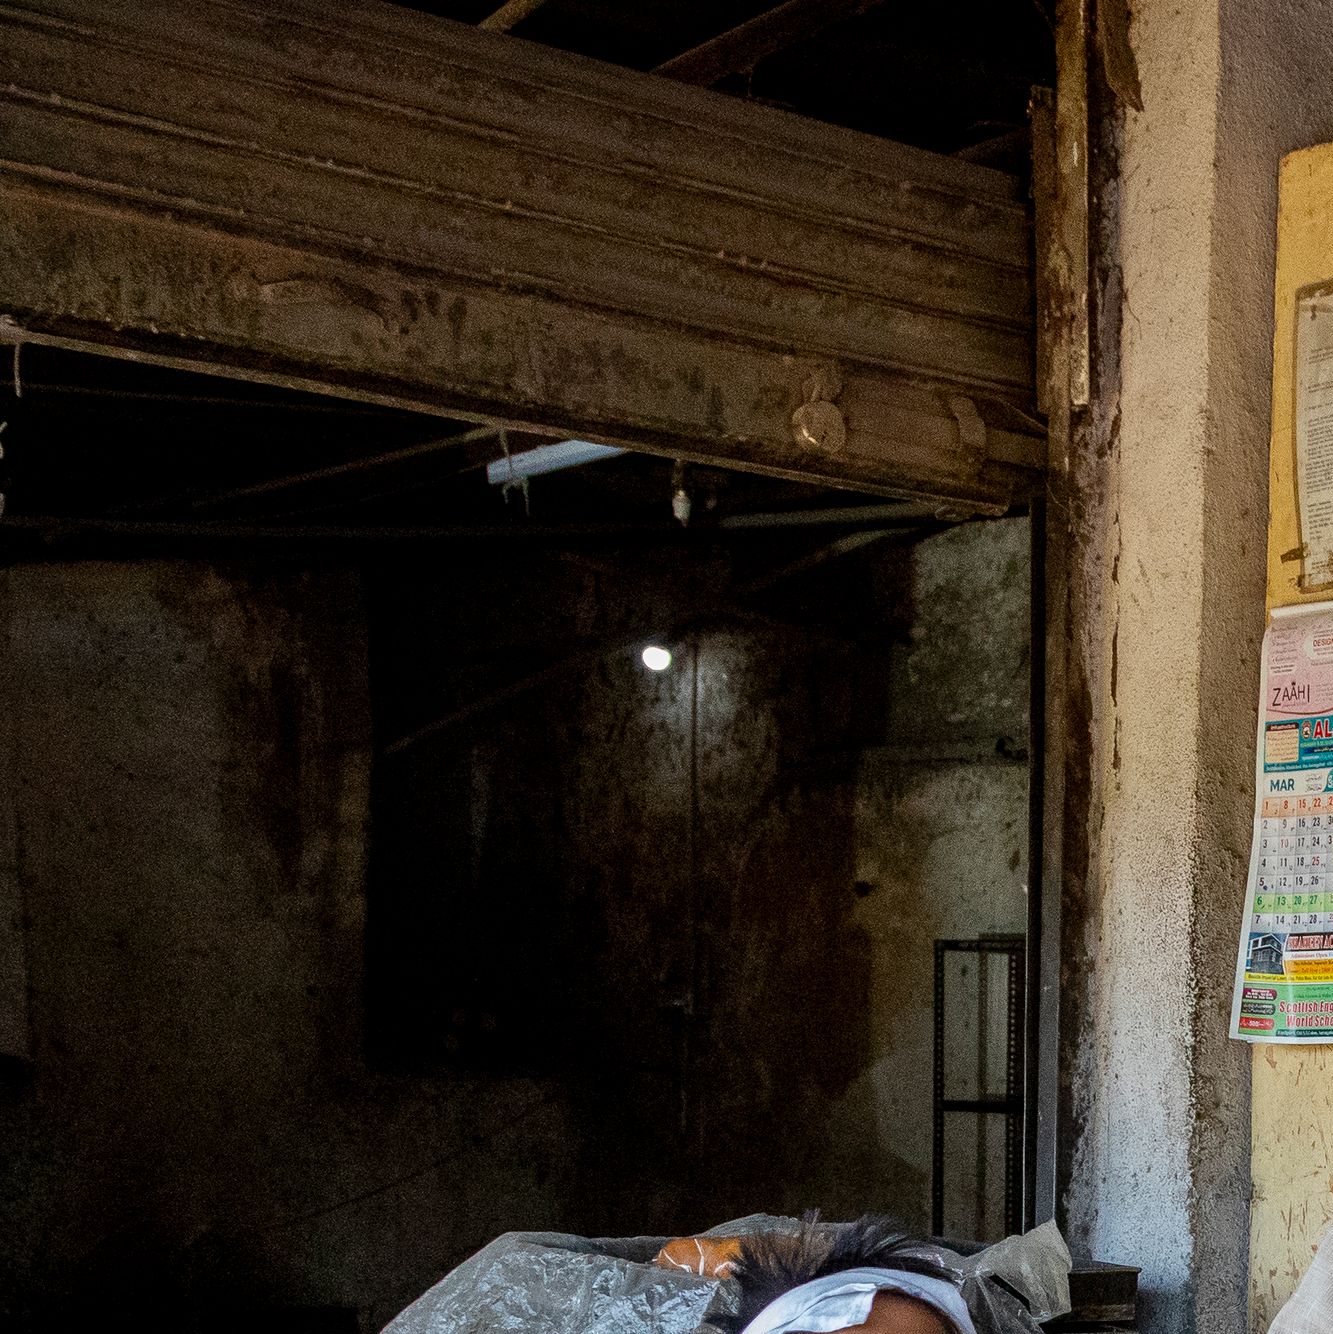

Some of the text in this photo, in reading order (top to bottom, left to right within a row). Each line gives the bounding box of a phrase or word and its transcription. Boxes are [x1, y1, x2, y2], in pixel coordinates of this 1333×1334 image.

[1270, 779, 1295, 792] MAR
[1265, 802, 1268, 810] 1
[1284, 800, 1288, 809] 8
[1300, 799, 1306, 808] 15
[1314, 798, 1320, 806] 22
[1263, 820, 1267, 829] 2
[1283, 819, 1287, 828] 9
[1313, 817, 1320, 826] 23
[1263, 840, 1267, 848] 3
[1298, 838, 1305, 846] 17
[1312, 837, 1320, 846] 24
[1262, 859, 1266, 867] 4
[1281, 858, 1288, 866] 11
[1297, 857, 1304, 866] 18
[1312, 857, 1320, 865] 25
[1260, 877, 1264, 886] 5
[1280, 877, 1287, 886] 12
[1296, 876, 1303, 885] 19
[1311, 876, 1319, 884] 26
[1257, 897, 1262, 906] 6
[1277, 896, 1286, 906] 13
[1310, 895, 1318, 904] 27
[1255, 916, 1260, 924] 7
[1276, 915, 1285, 924] 14
[1294, 915, 1300, 924] 21
[1309, 915, 1317, 923] 28
[1279, 1001, 1319, 1014] Scottish
[1286, 1015, 1314, 1028] World
